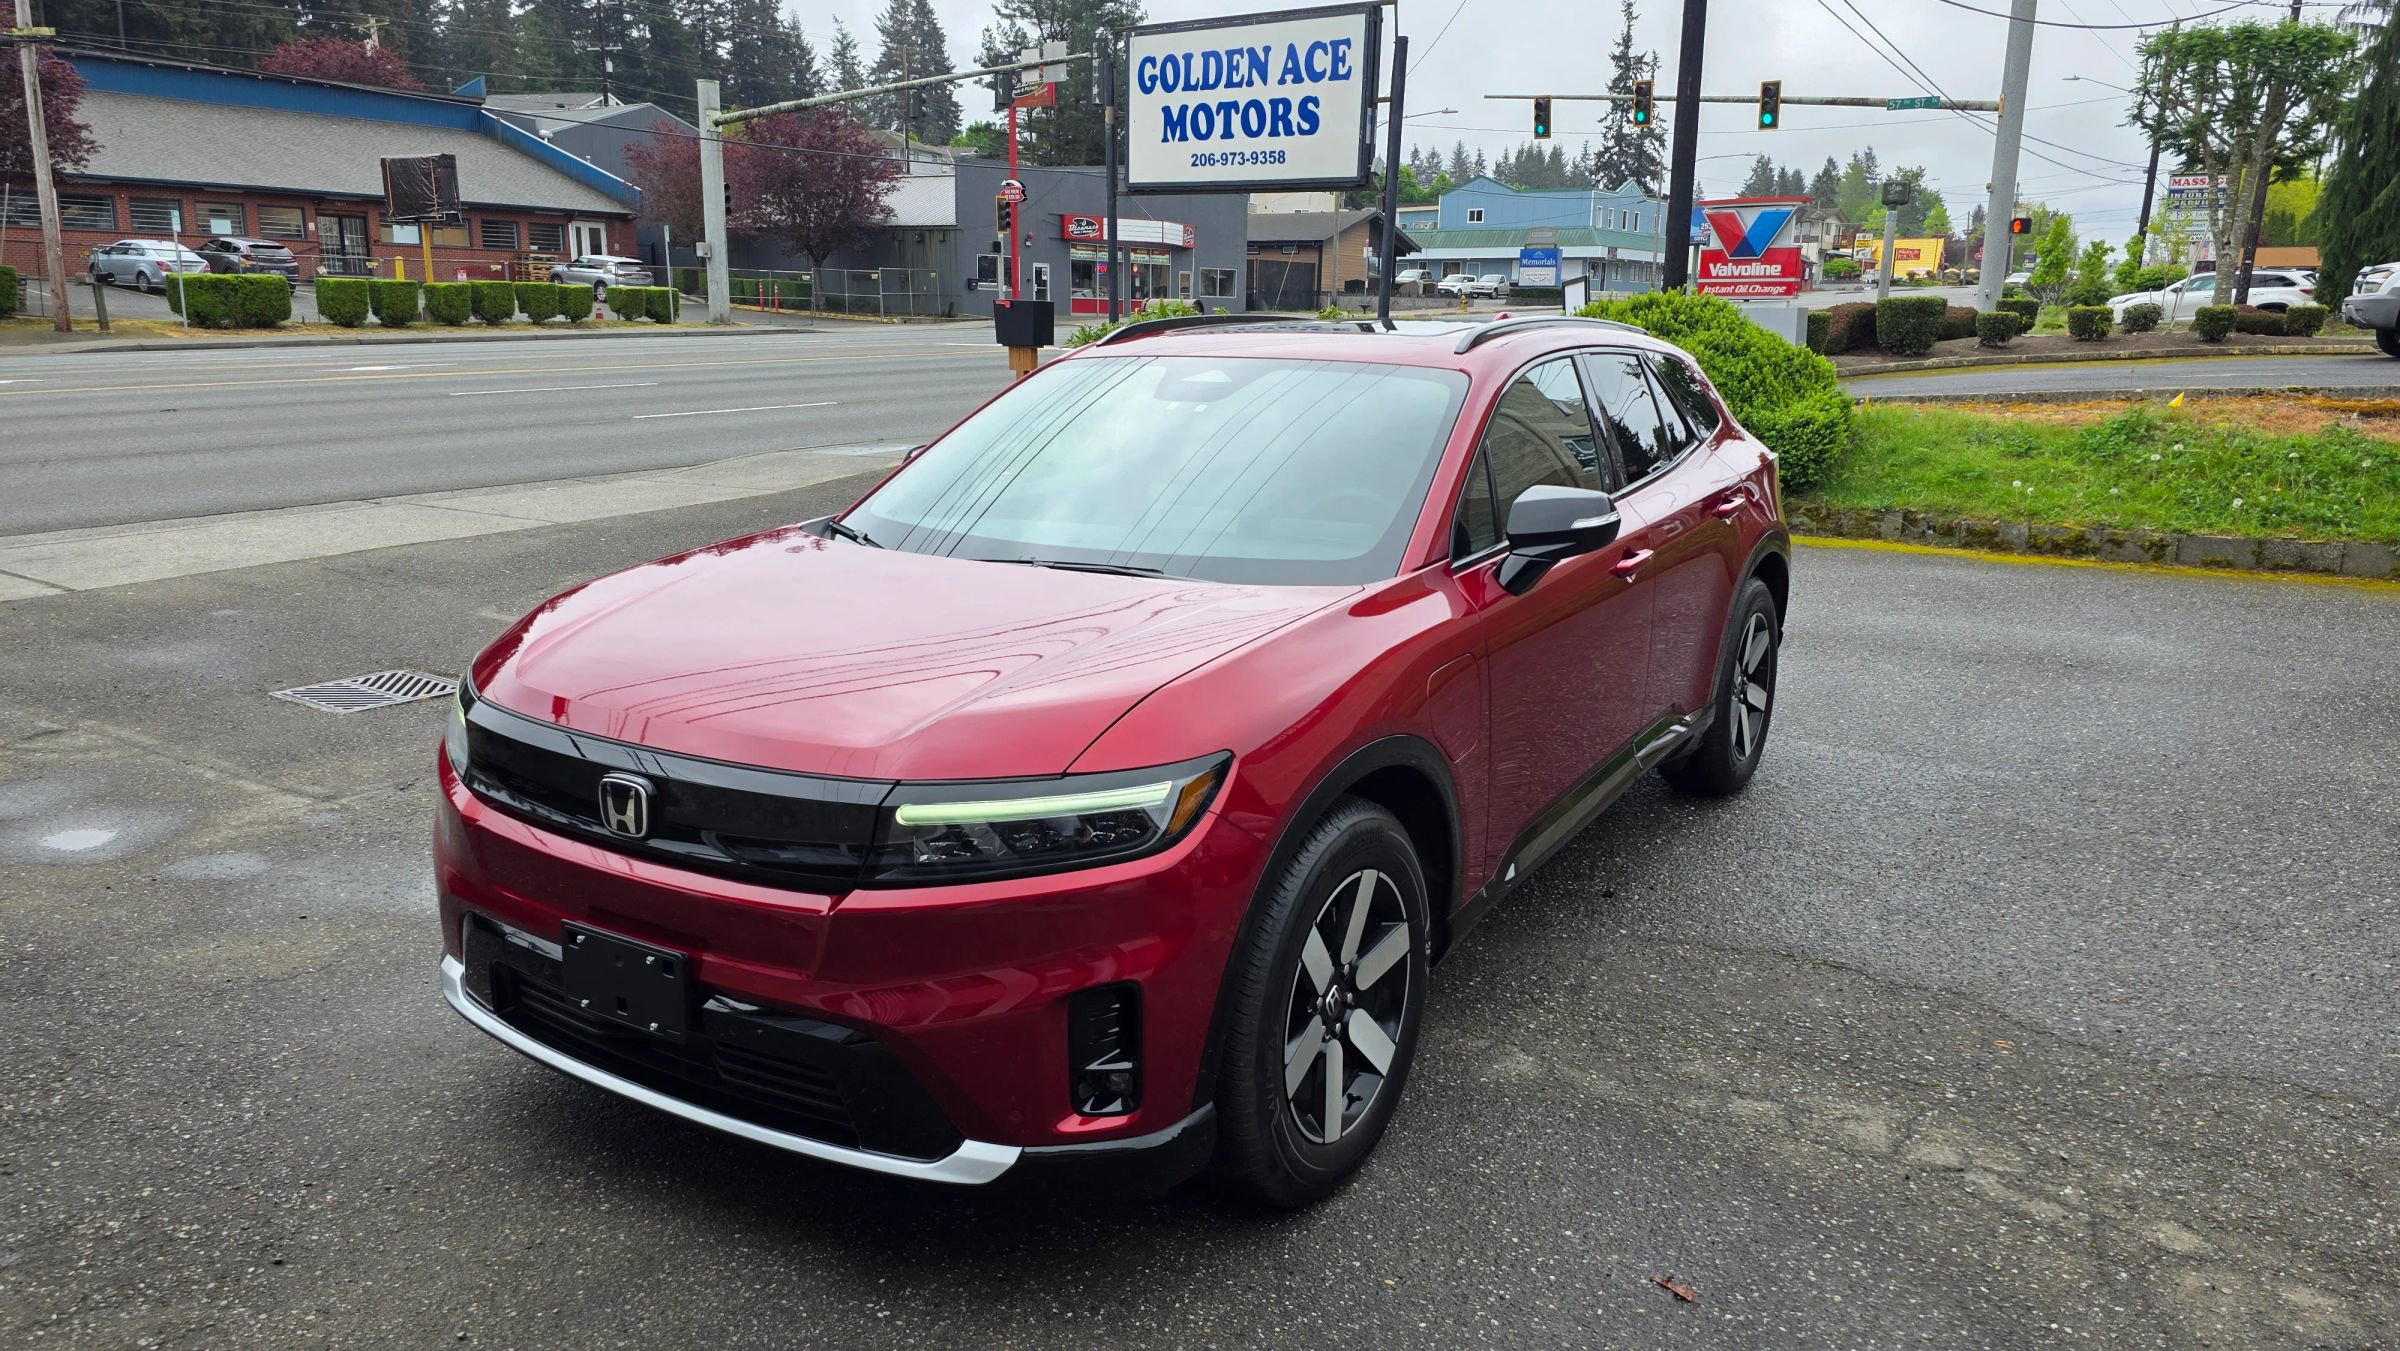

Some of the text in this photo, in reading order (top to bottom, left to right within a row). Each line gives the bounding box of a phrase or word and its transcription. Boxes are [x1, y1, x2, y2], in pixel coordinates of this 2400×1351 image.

[1137, 37, 1352, 95] GOLDEN ACE
[1914, 98, 1927, 108] ST
[1161, 95, 1320, 143] MOTORS
[1191, 150, 1286, 167] 206-973-9358
[1709, 262, 1782, 276] Valvoline
[1703, 284, 1787, 295] Instant Oil Change
